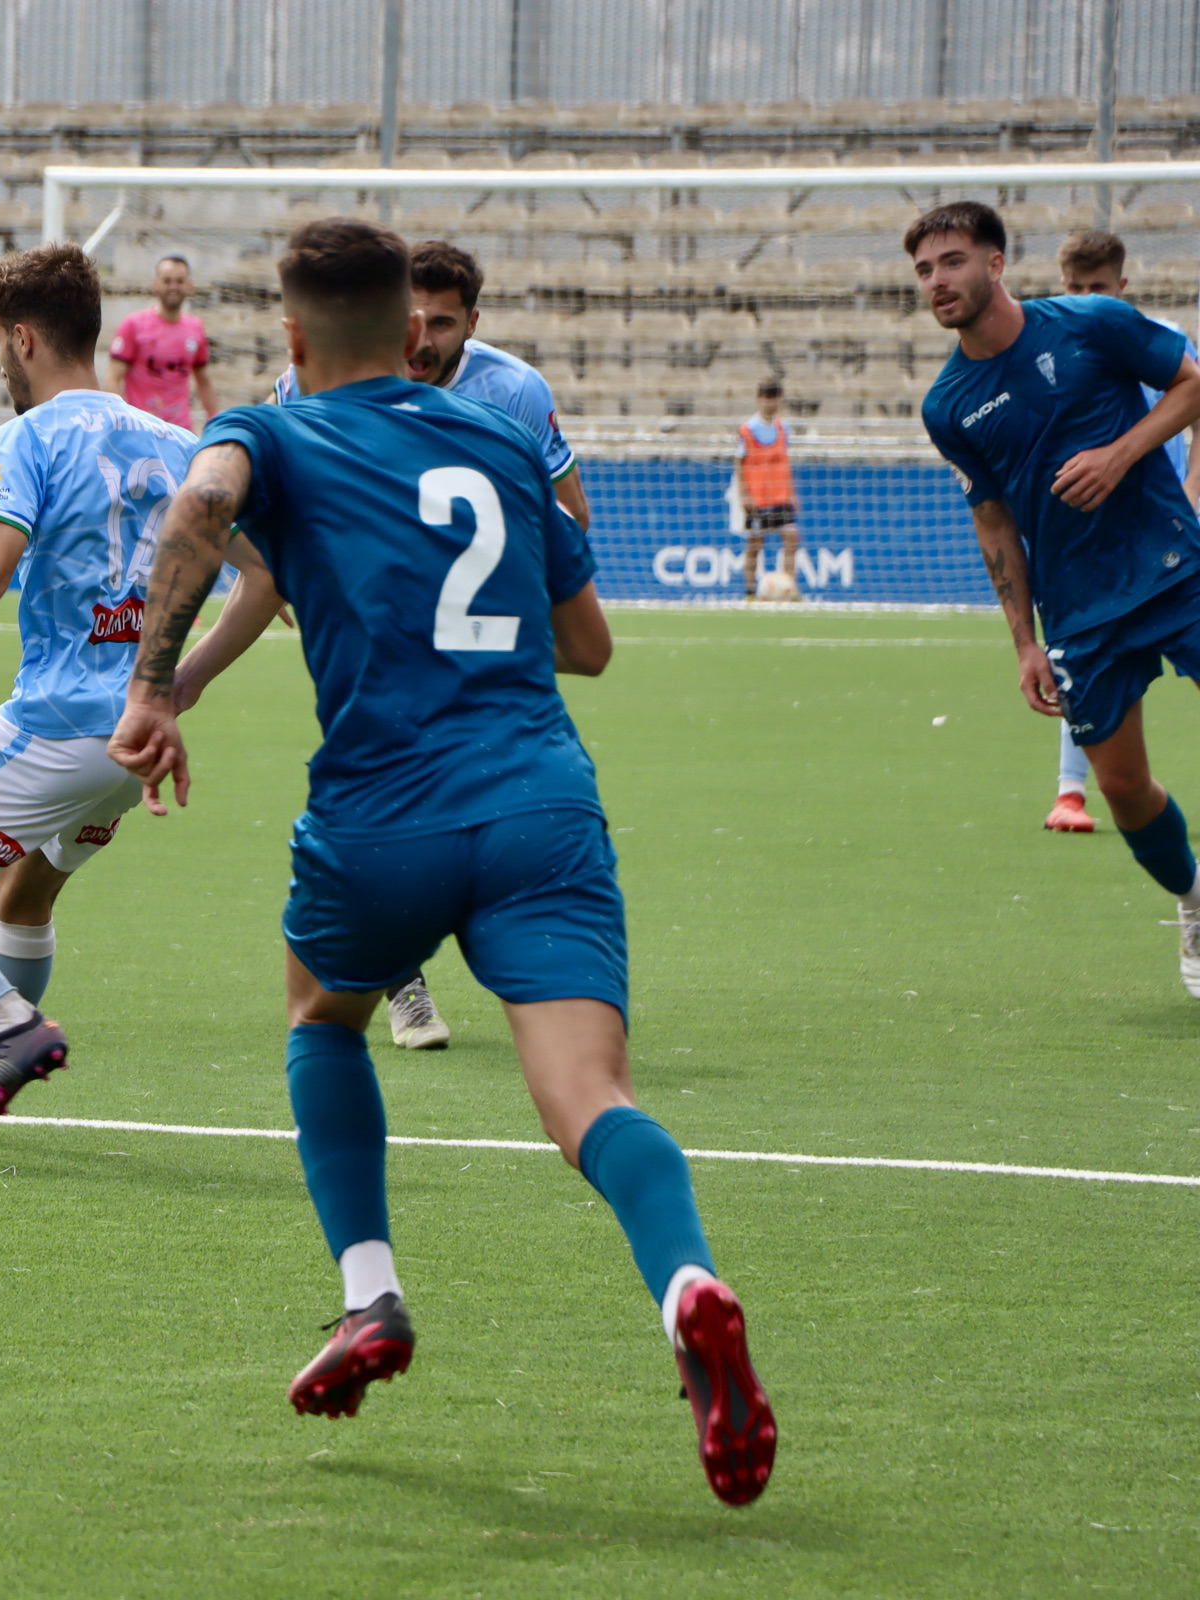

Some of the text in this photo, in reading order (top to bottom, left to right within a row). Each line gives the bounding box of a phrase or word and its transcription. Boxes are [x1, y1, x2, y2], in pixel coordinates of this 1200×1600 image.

[962, 392, 1010, 428] GIVOVA
[96, 455, 179, 590] 12
[418, 466, 521, 652] 2
[1044, 645, 1073, 692] 5
